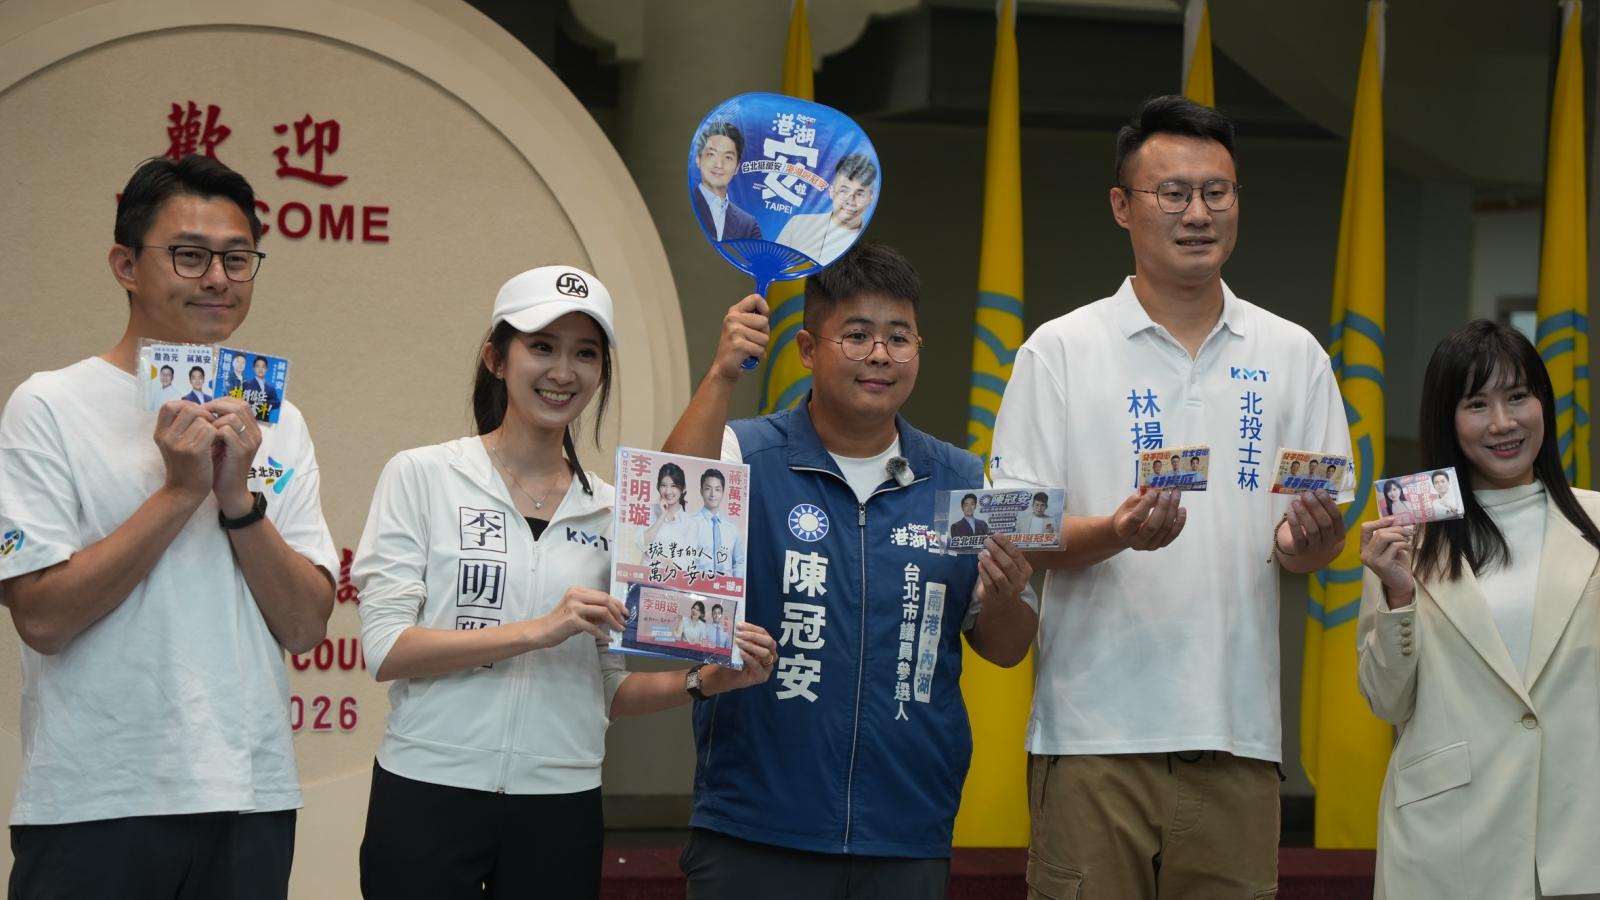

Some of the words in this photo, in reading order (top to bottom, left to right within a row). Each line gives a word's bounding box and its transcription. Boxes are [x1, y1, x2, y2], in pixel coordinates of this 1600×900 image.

[764, 200, 793, 214] TAIPEI
[1230, 366, 1269, 383] KMT
[1127, 388, 1164, 490] 林揚
[1237, 391, 1263, 492] 北投士林
[628, 454, 652, 528] 李明璇
[728, 470, 742, 517] 蔣萬安
[566, 527, 612, 551] KMT
[648, 542, 713, 559] 璇對的人
[648, 560, 725, 585] 萬分安心
[775, 549, 829, 703] 陳冠安
[894, 562, 921, 721] 台北市議員參選人
[291, 638, 366, 671] COU
[290, 695, 357, 731] 026
